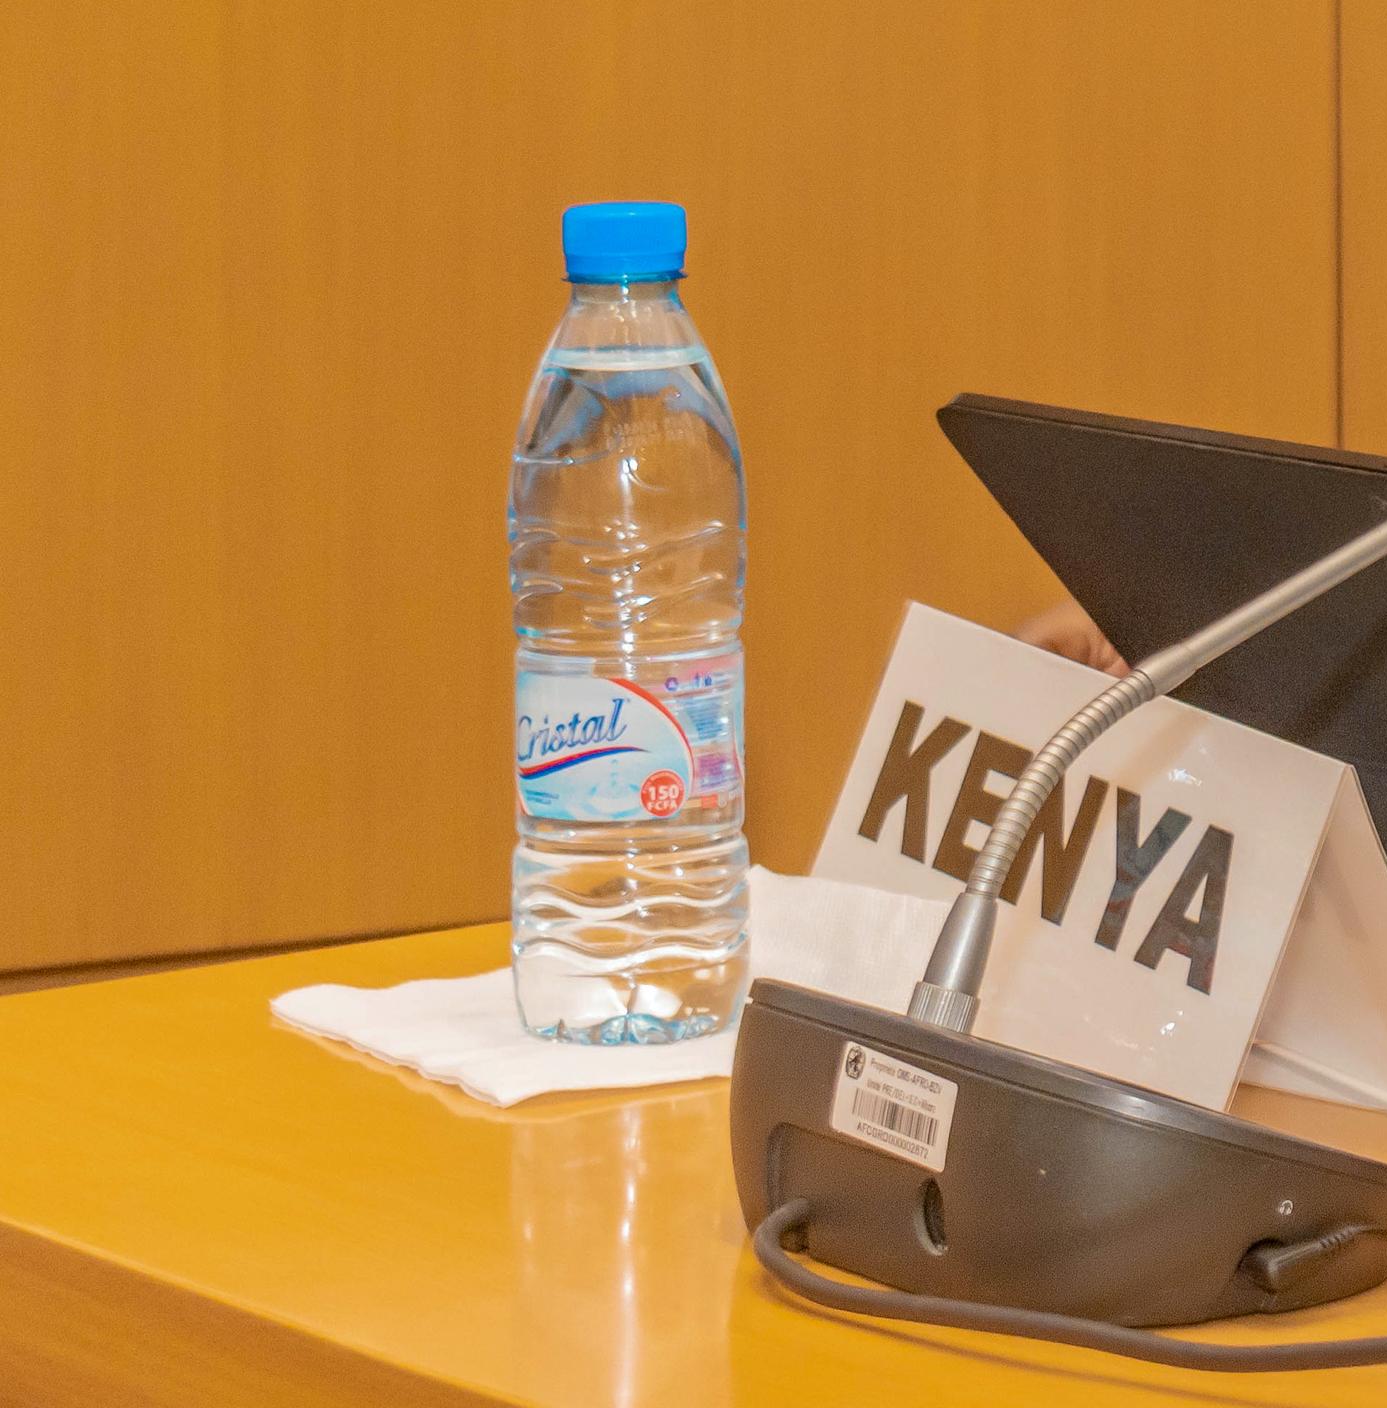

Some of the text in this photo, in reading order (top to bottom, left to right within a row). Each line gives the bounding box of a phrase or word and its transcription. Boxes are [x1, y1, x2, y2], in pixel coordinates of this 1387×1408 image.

[516, 697, 627, 763] Cristal
[648, 784, 680, 801] 150
[857, 698, 1237, 996] KENYA
